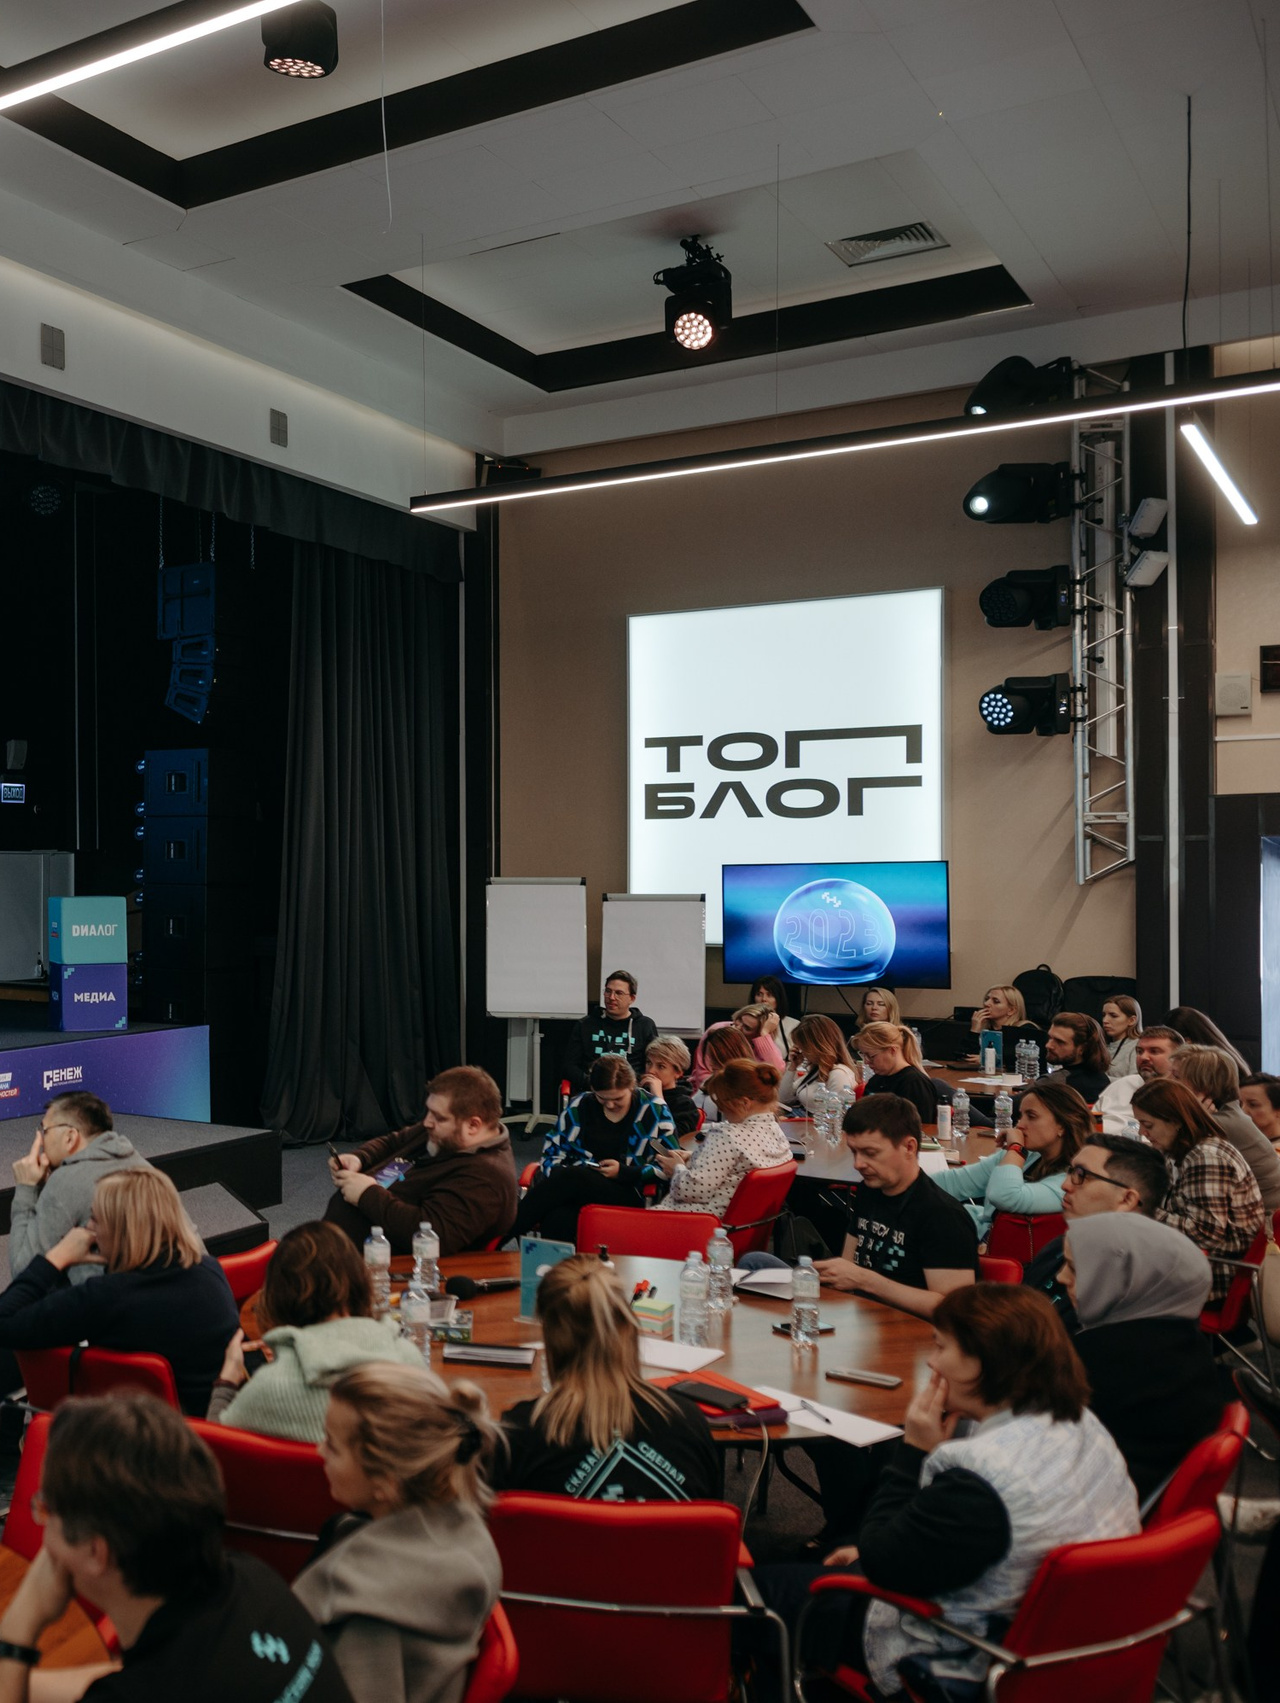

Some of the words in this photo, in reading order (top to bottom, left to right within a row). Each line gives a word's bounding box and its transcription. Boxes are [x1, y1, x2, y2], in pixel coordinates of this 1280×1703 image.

[644, 724, 923, 773] ТОП
[644, 775, 923, 820] БЛОГ
[783, 908, 883, 960] 2023
[74, 991, 116, 1004] МЕДИА
[637, 1441, 686, 1485] СДЕЛАЛ
